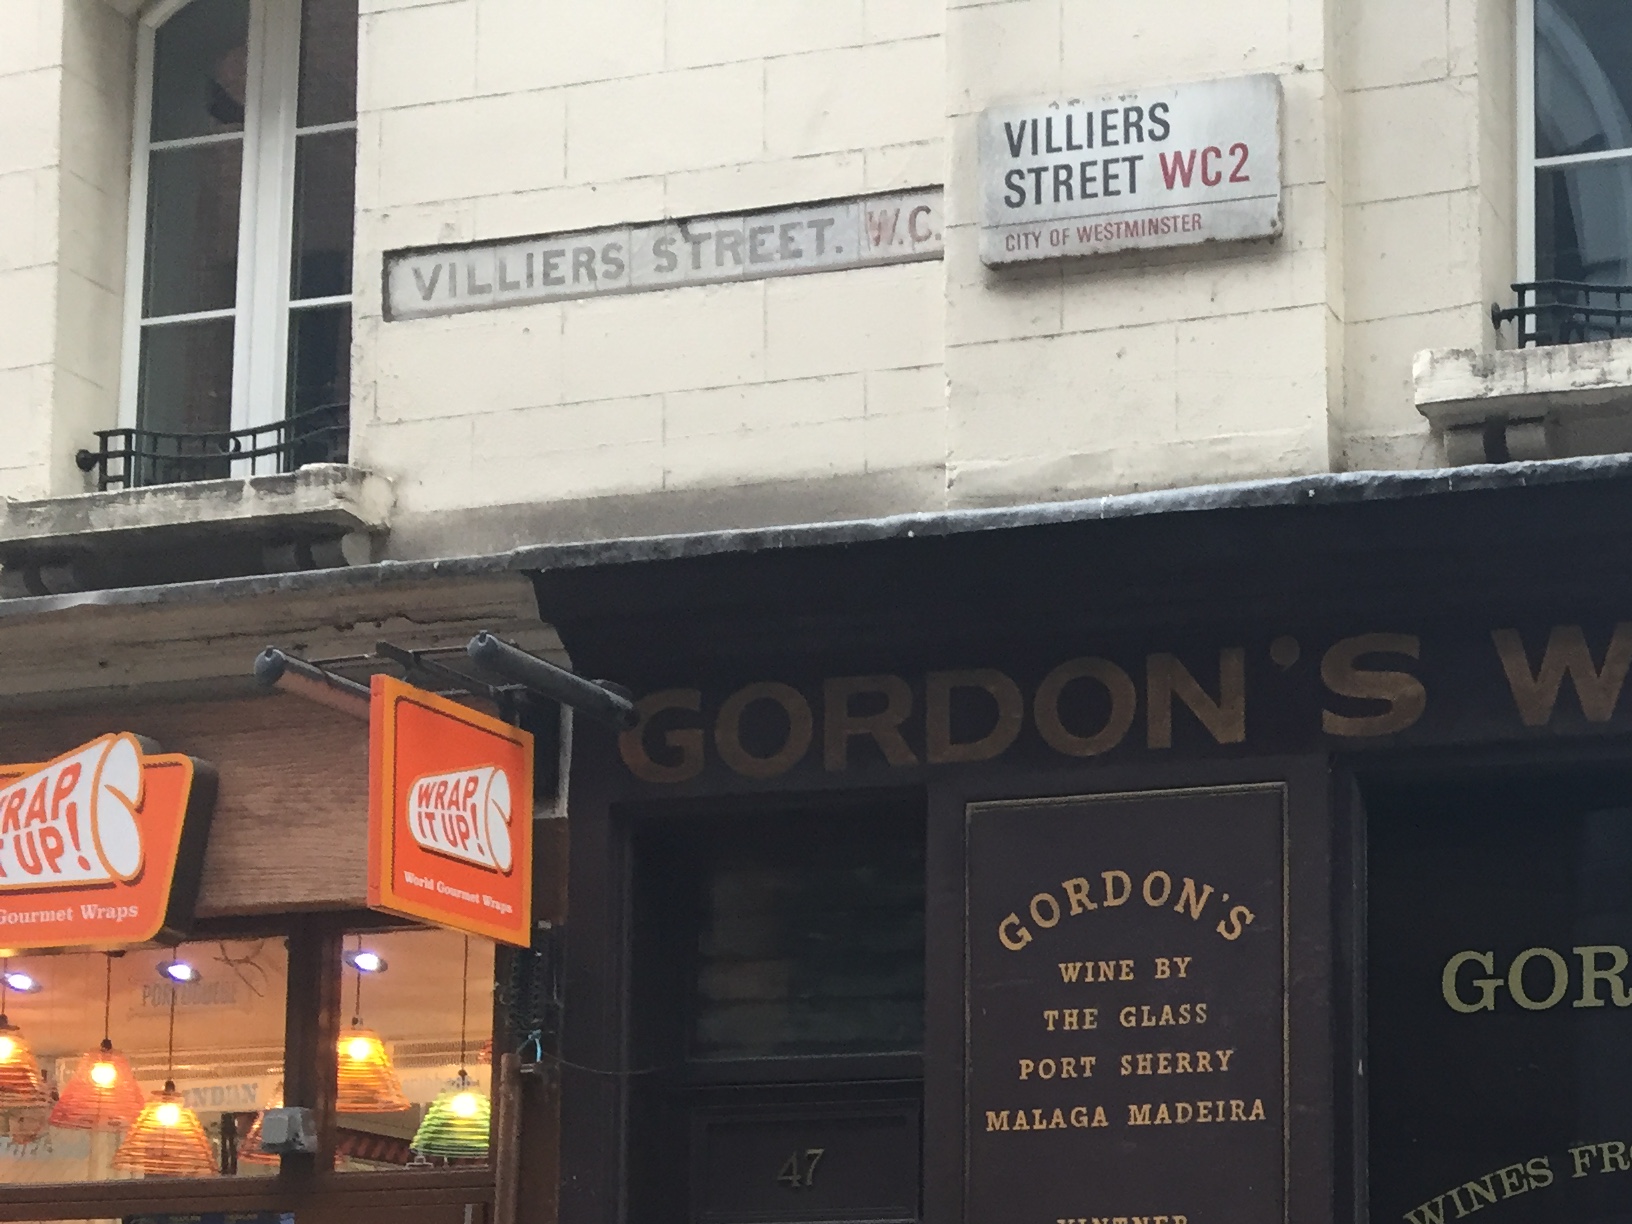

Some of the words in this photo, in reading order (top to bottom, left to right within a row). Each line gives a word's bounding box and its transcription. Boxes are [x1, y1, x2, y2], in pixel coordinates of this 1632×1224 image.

[1004, 101, 1171, 158] VILLIERS
[1004, 155, 1143, 209] STREET
[1159, 142, 1250, 190] WC2
[1005, 231, 1042, 252] CITY
[1050, 228, 1070, 248] OF
[1077, 213, 1202, 244] WESTMINSTER
[412, 242, 625, 301] VILLIERS
[619, 633, 1426, 784] GORDON'S
[0, 762, 82, 834] RAP
[417, 776, 479, 812] WRAP
[13, 802, 91, 876] UP!
[417, 811, 438, 843] IT
[441, 802, 485, 856] UP!
[404, 871, 435, 891] World
[437, 880, 480, 904] Gourmet
[482, 894, 513, 914] Wraps
[998, 869, 1256, 952] GORDON'S
[0, 907, 73, 925] Gourmet
[80, 904, 139, 923] Wraps
[1058, 959, 1136, 984] WINE
[1154, 957, 1193, 980] BY
[1043, 1008, 1099, 1032] THE
[1119, 1003, 1209, 1028] GLASS
[1018, 1056, 1097, 1081] PORT
[1120, 1049, 1234, 1076] SHERRY
[985, 1105, 1110, 1132] MALAGA
[1127, 1099, 1268, 1127] MADEIRA
[776, 1148, 825, 1190] 47
